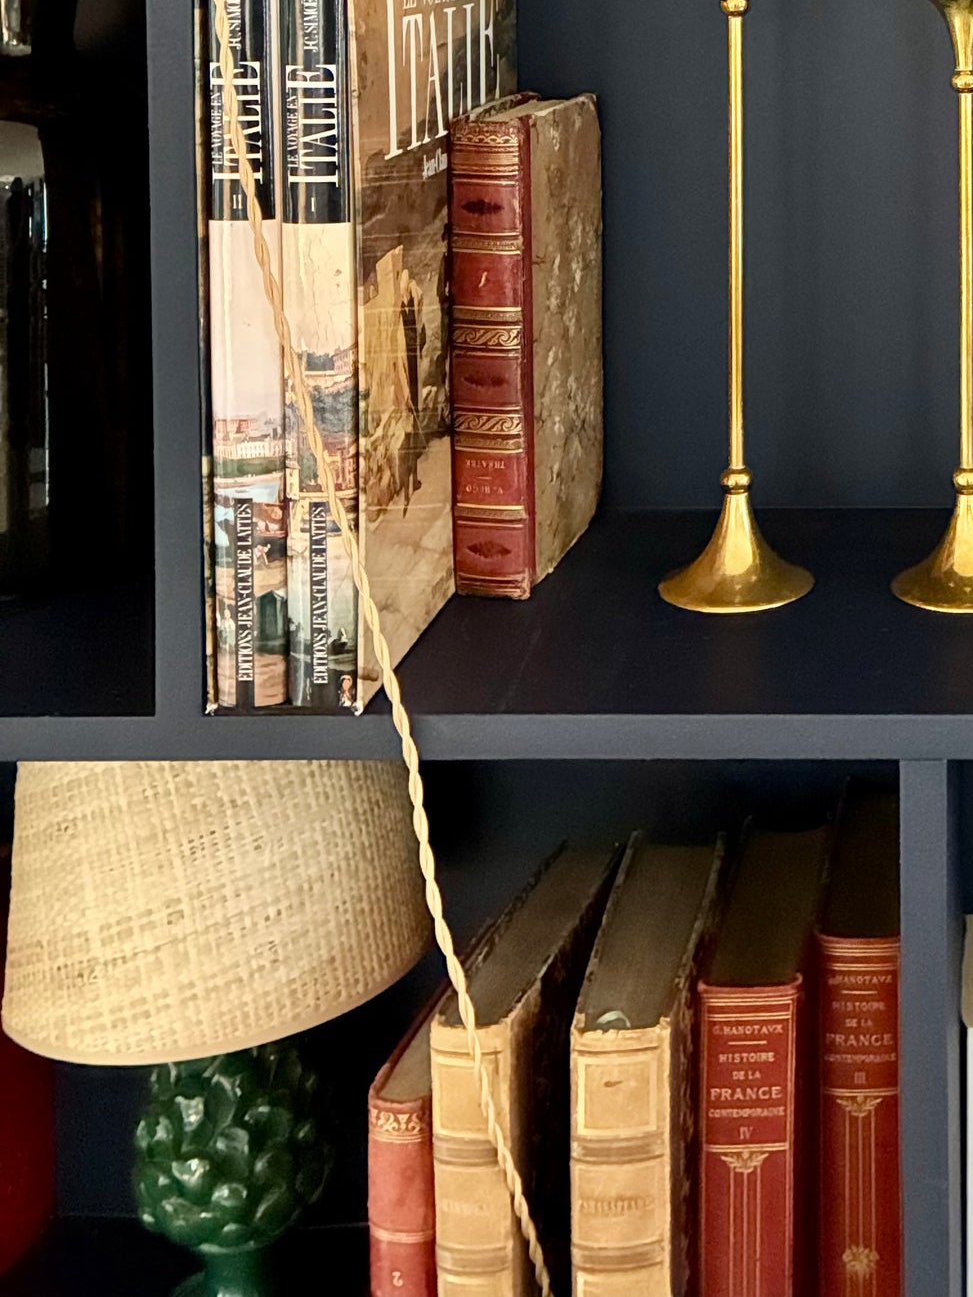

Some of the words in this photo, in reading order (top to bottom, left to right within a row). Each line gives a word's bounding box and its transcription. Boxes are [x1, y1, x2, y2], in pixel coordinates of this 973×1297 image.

[211, 91, 222, 109] EN
[287, 94, 297, 112] EN
[210, 61, 263, 185] ITALIE
[211, 110, 223, 148] VOYAGE
[286, 63, 339, 188] ITALIE
[287, 113, 301, 153] VOYAGE
[211, 150, 223, 166] LE
[287, 154, 300, 168] LE
[237, 550, 253, 632] JEAN-CLAUDE
[311, 553, 328, 634] JEAN-CLAUDE
[826, 1033, 894, 1047] FRANCE
[719, 1052, 775, 1063] HISTOIRE
[732, 1071, 745, 1080] DE
[748, 1070, 761, 1079] LA
[710, 1086, 783, 1101] FRANCE
[740, 1126, 753, 1140] IV
